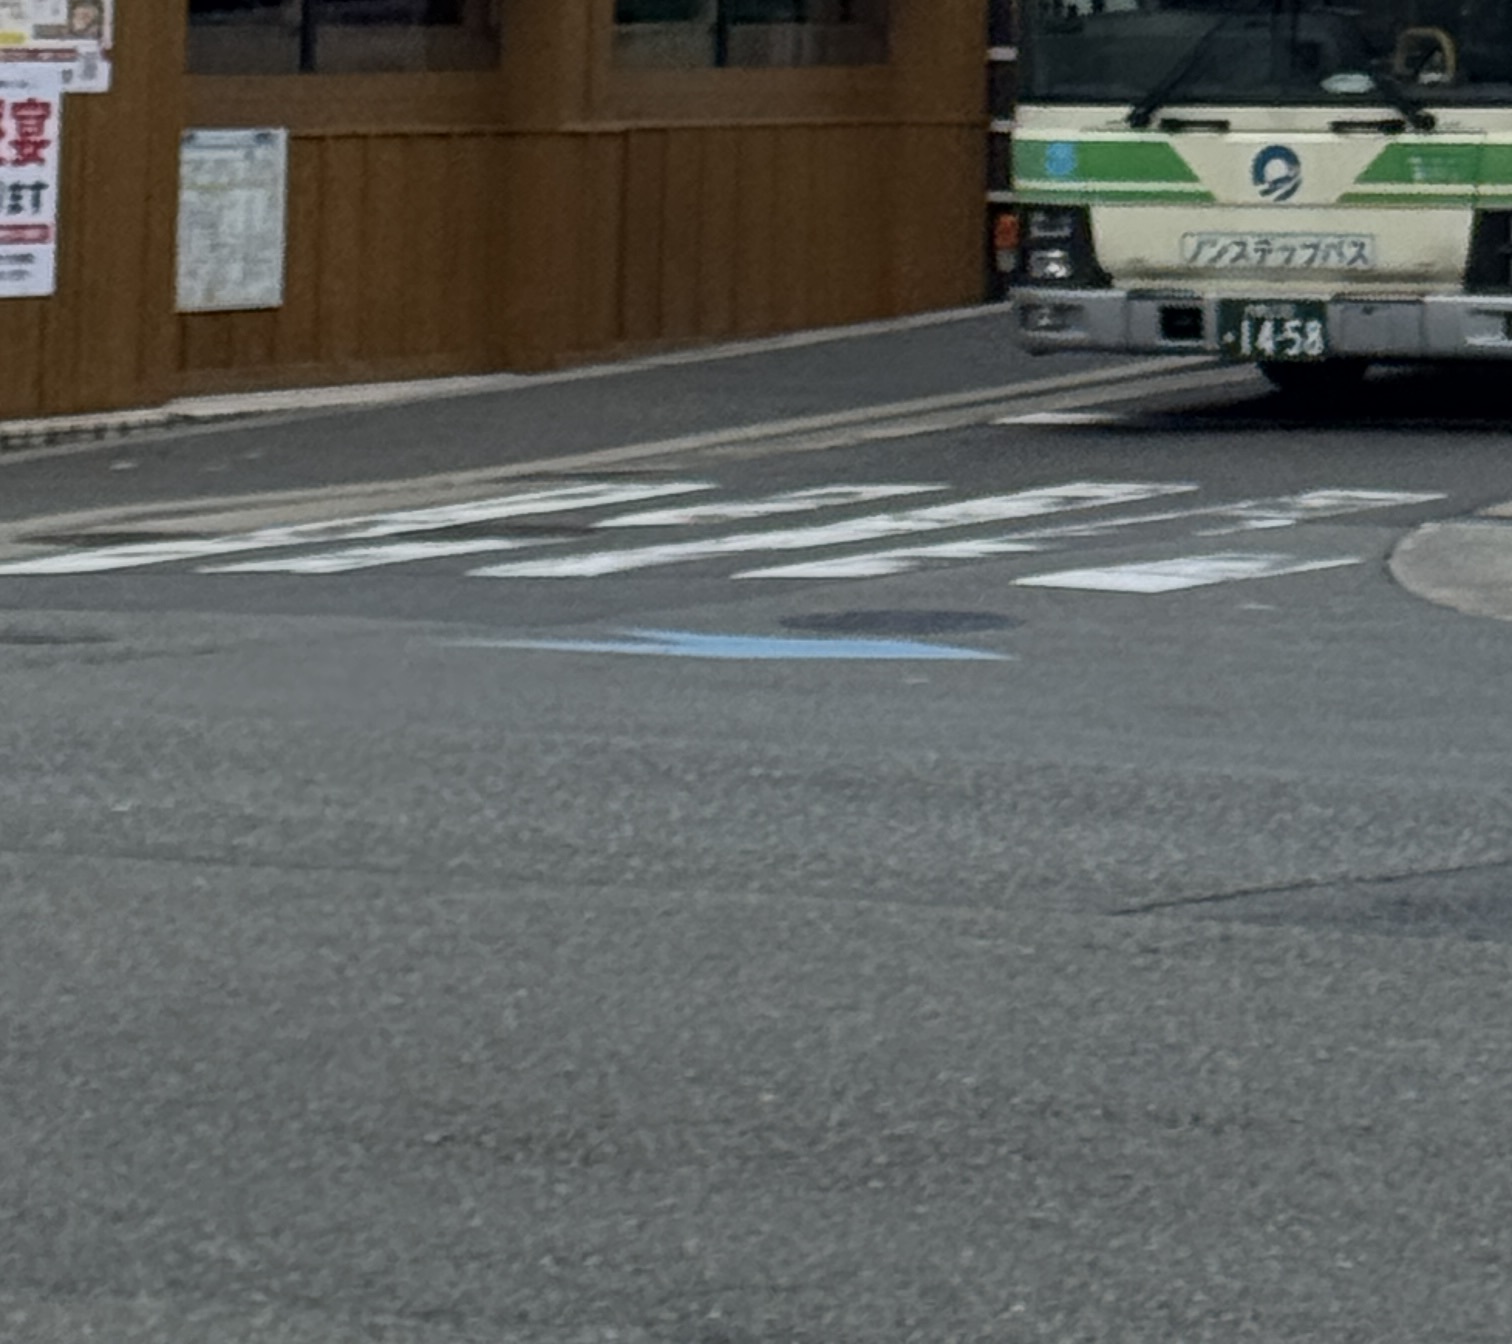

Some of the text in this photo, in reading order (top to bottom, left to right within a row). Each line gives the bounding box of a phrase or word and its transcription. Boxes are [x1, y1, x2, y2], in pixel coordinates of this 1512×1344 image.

[1190, 238, 1369, 266] ノンステップバス
